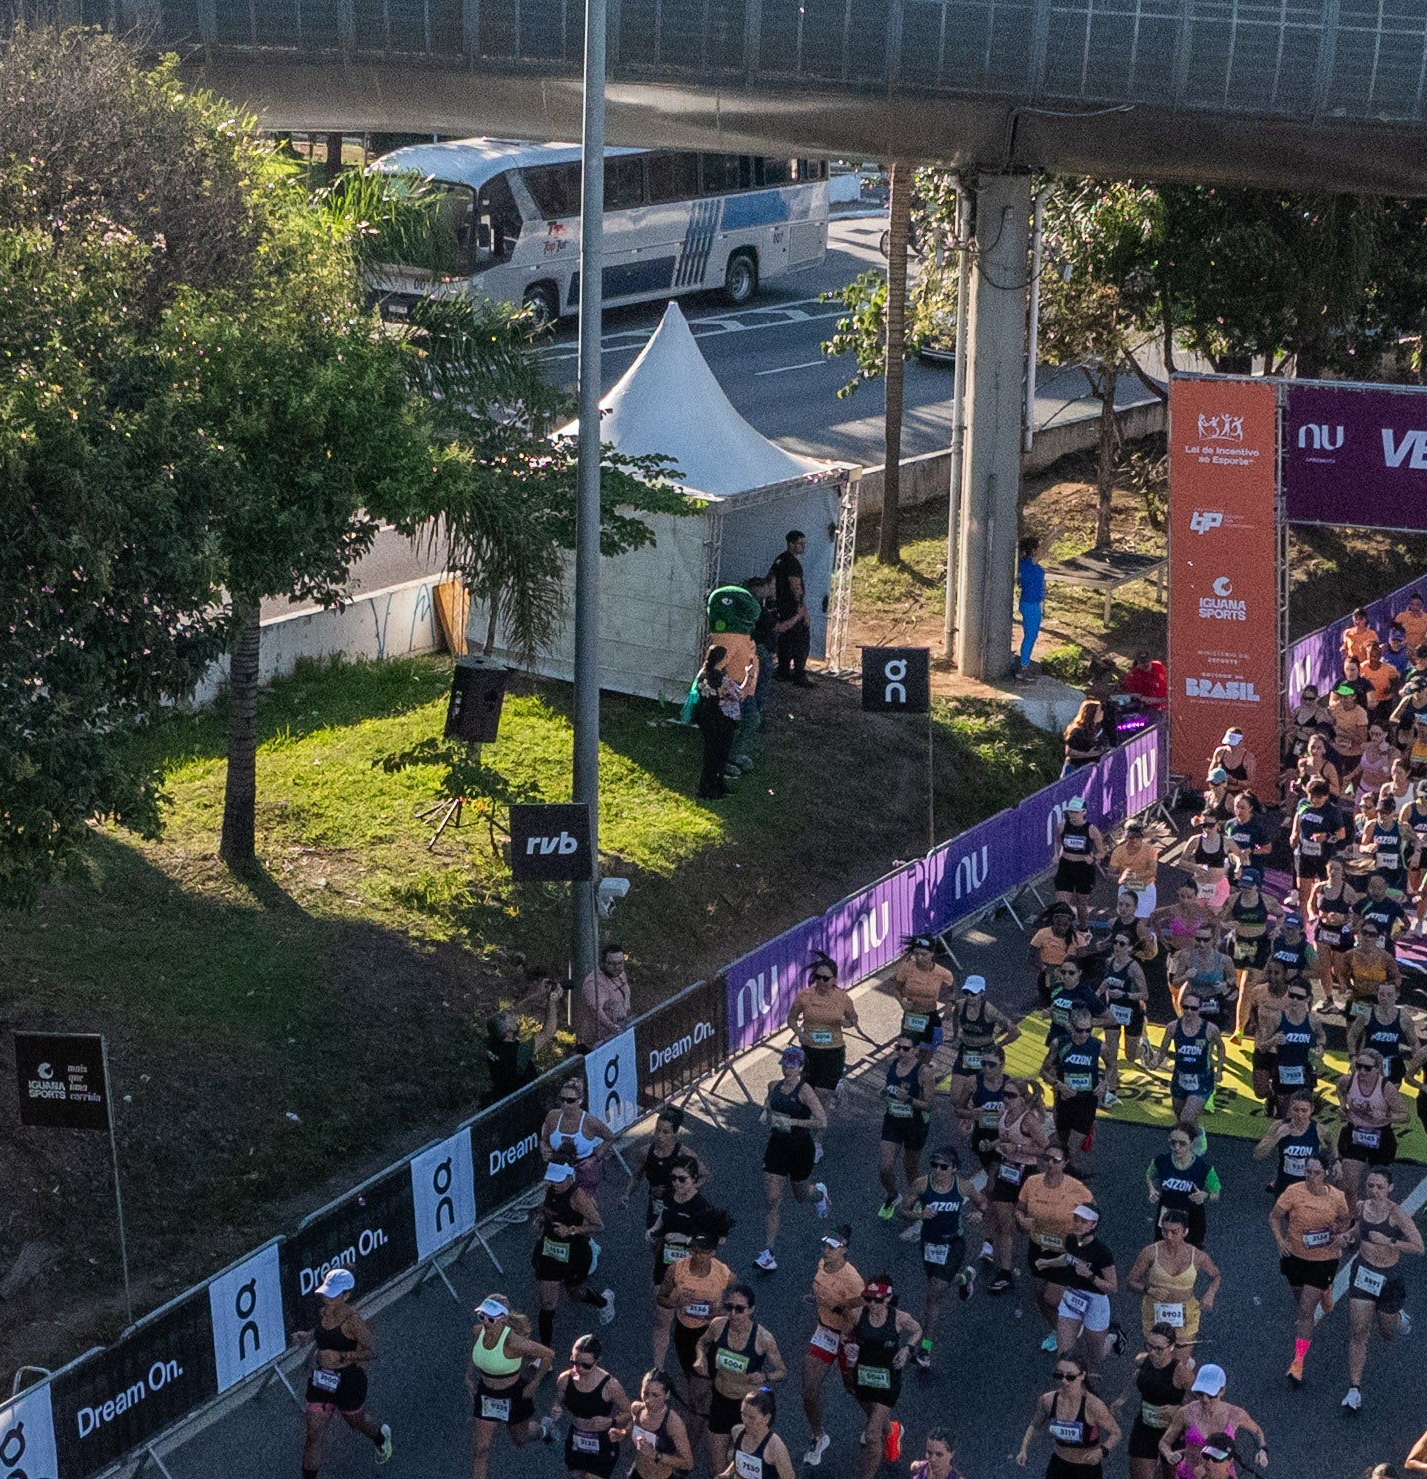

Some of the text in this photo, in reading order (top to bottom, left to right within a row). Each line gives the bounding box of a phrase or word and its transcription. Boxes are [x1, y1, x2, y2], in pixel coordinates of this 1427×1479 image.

[1298, 423, 1344, 450] nu
[1184, 445, 1260, 457] Lei de Incentivo
[1212, 456, 1249, 466] Esporte
[1198, 608, 1247, 621] SPORTS
[1199, 597, 1247, 611] IGUANA
[1185, 677, 1261, 702] BRASIL
[526, 832, 578, 856] rvb
[955, 845, 988, 900] nu
[852, 901, 889, 961] nu
[737, 964, 779, 1029] nu
[649, 1020, 715, 1074] Dream On.
[28, 1080, 66, 1091] IGUANA
[28, 1089, 66, 1100] SPORTS
[489, 1132, 539, 1177] Dream
[358, 1226, 389, 1257] On.
[76, 1359, 184, 1441] Dream On.
